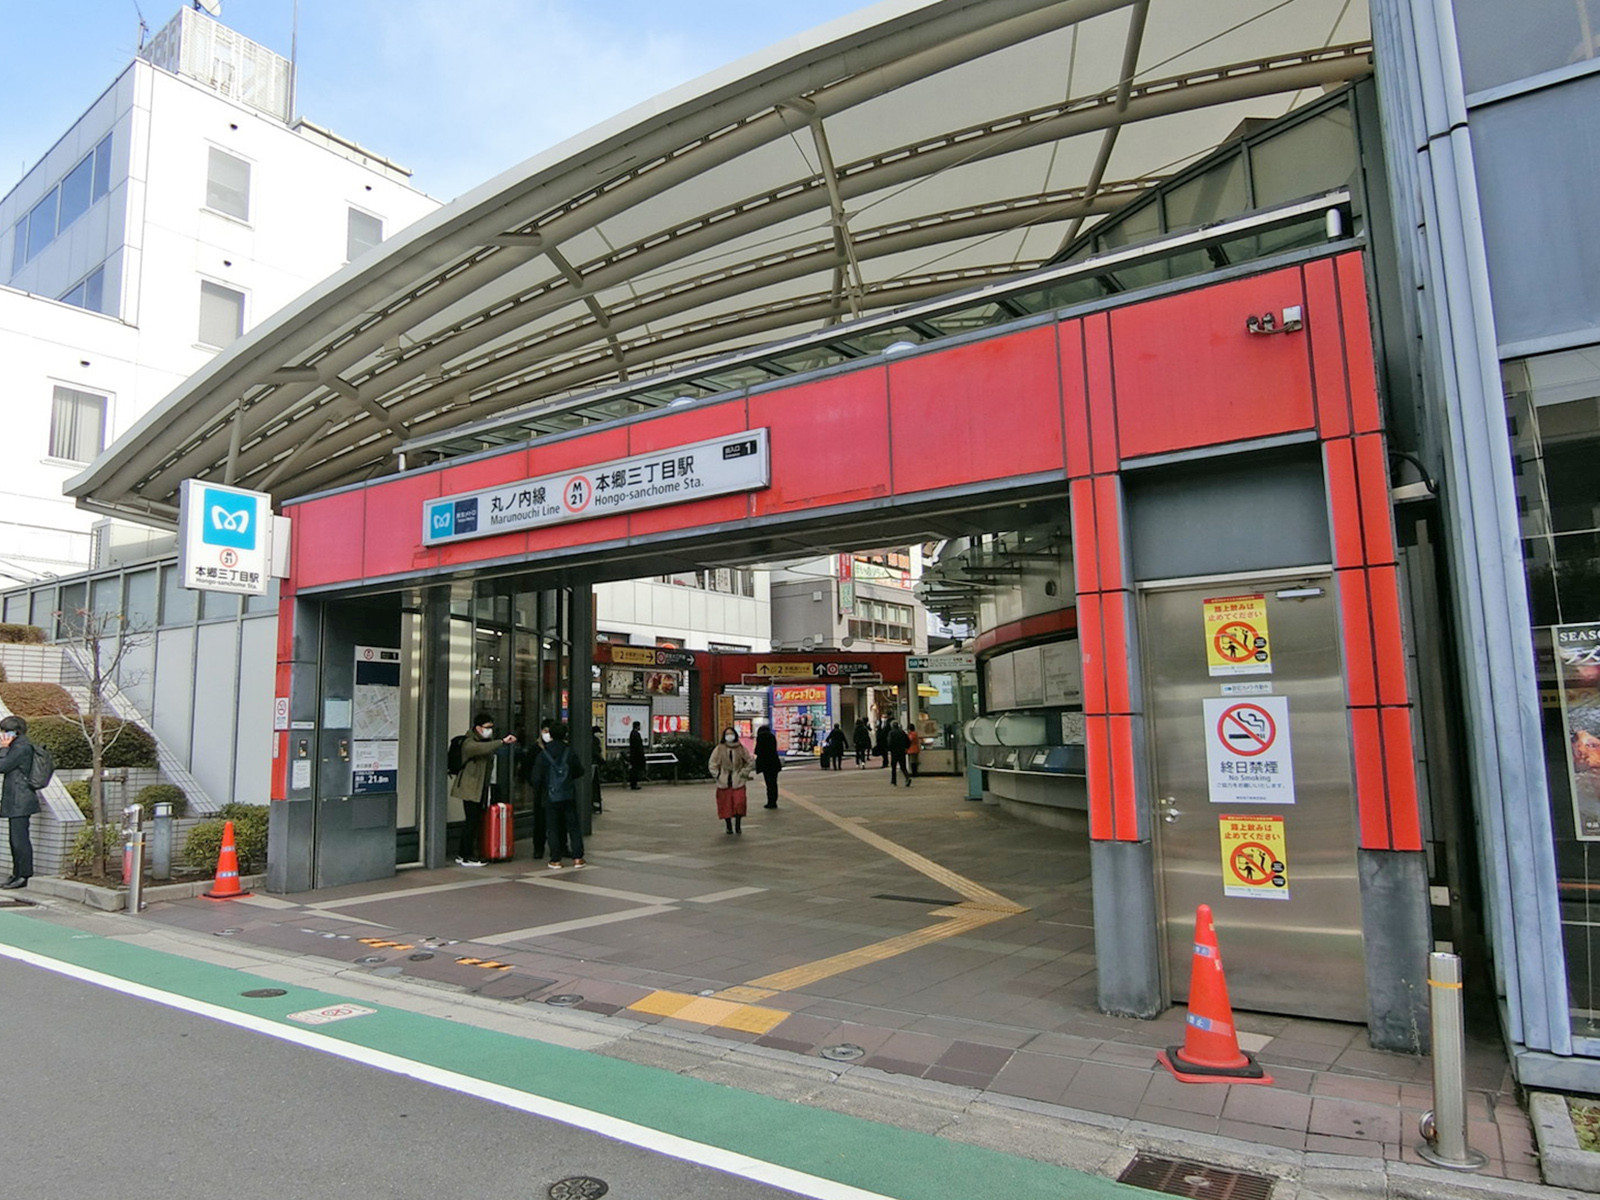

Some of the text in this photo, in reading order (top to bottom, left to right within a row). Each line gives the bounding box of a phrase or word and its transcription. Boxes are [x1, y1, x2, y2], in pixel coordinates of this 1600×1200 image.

[745, 442, 751, 454] 1
[595, 455, 694, 492] 本郷三丁目駅
[573, 481, 582, 493] M
[595, 477, 704, 506] Hongo-sanchome Sta.
[490, 486, 546, 513] 丸ノ内線
[571, 493, 583, 505] 21
[490, 504, 560, 526] Marunouchi Line
[195, 566, 259, 583] 本郷三丁目駅
[1208, 611, 1263, 621] 止めてください
[1220, 761, 1278, 774] 終日禁煙
[1240, 774, 1271, 782] Smoking
[1230, 823, 1272, 832] 路上飲みは
[1224, 832, 1281, 840] 止めてください
